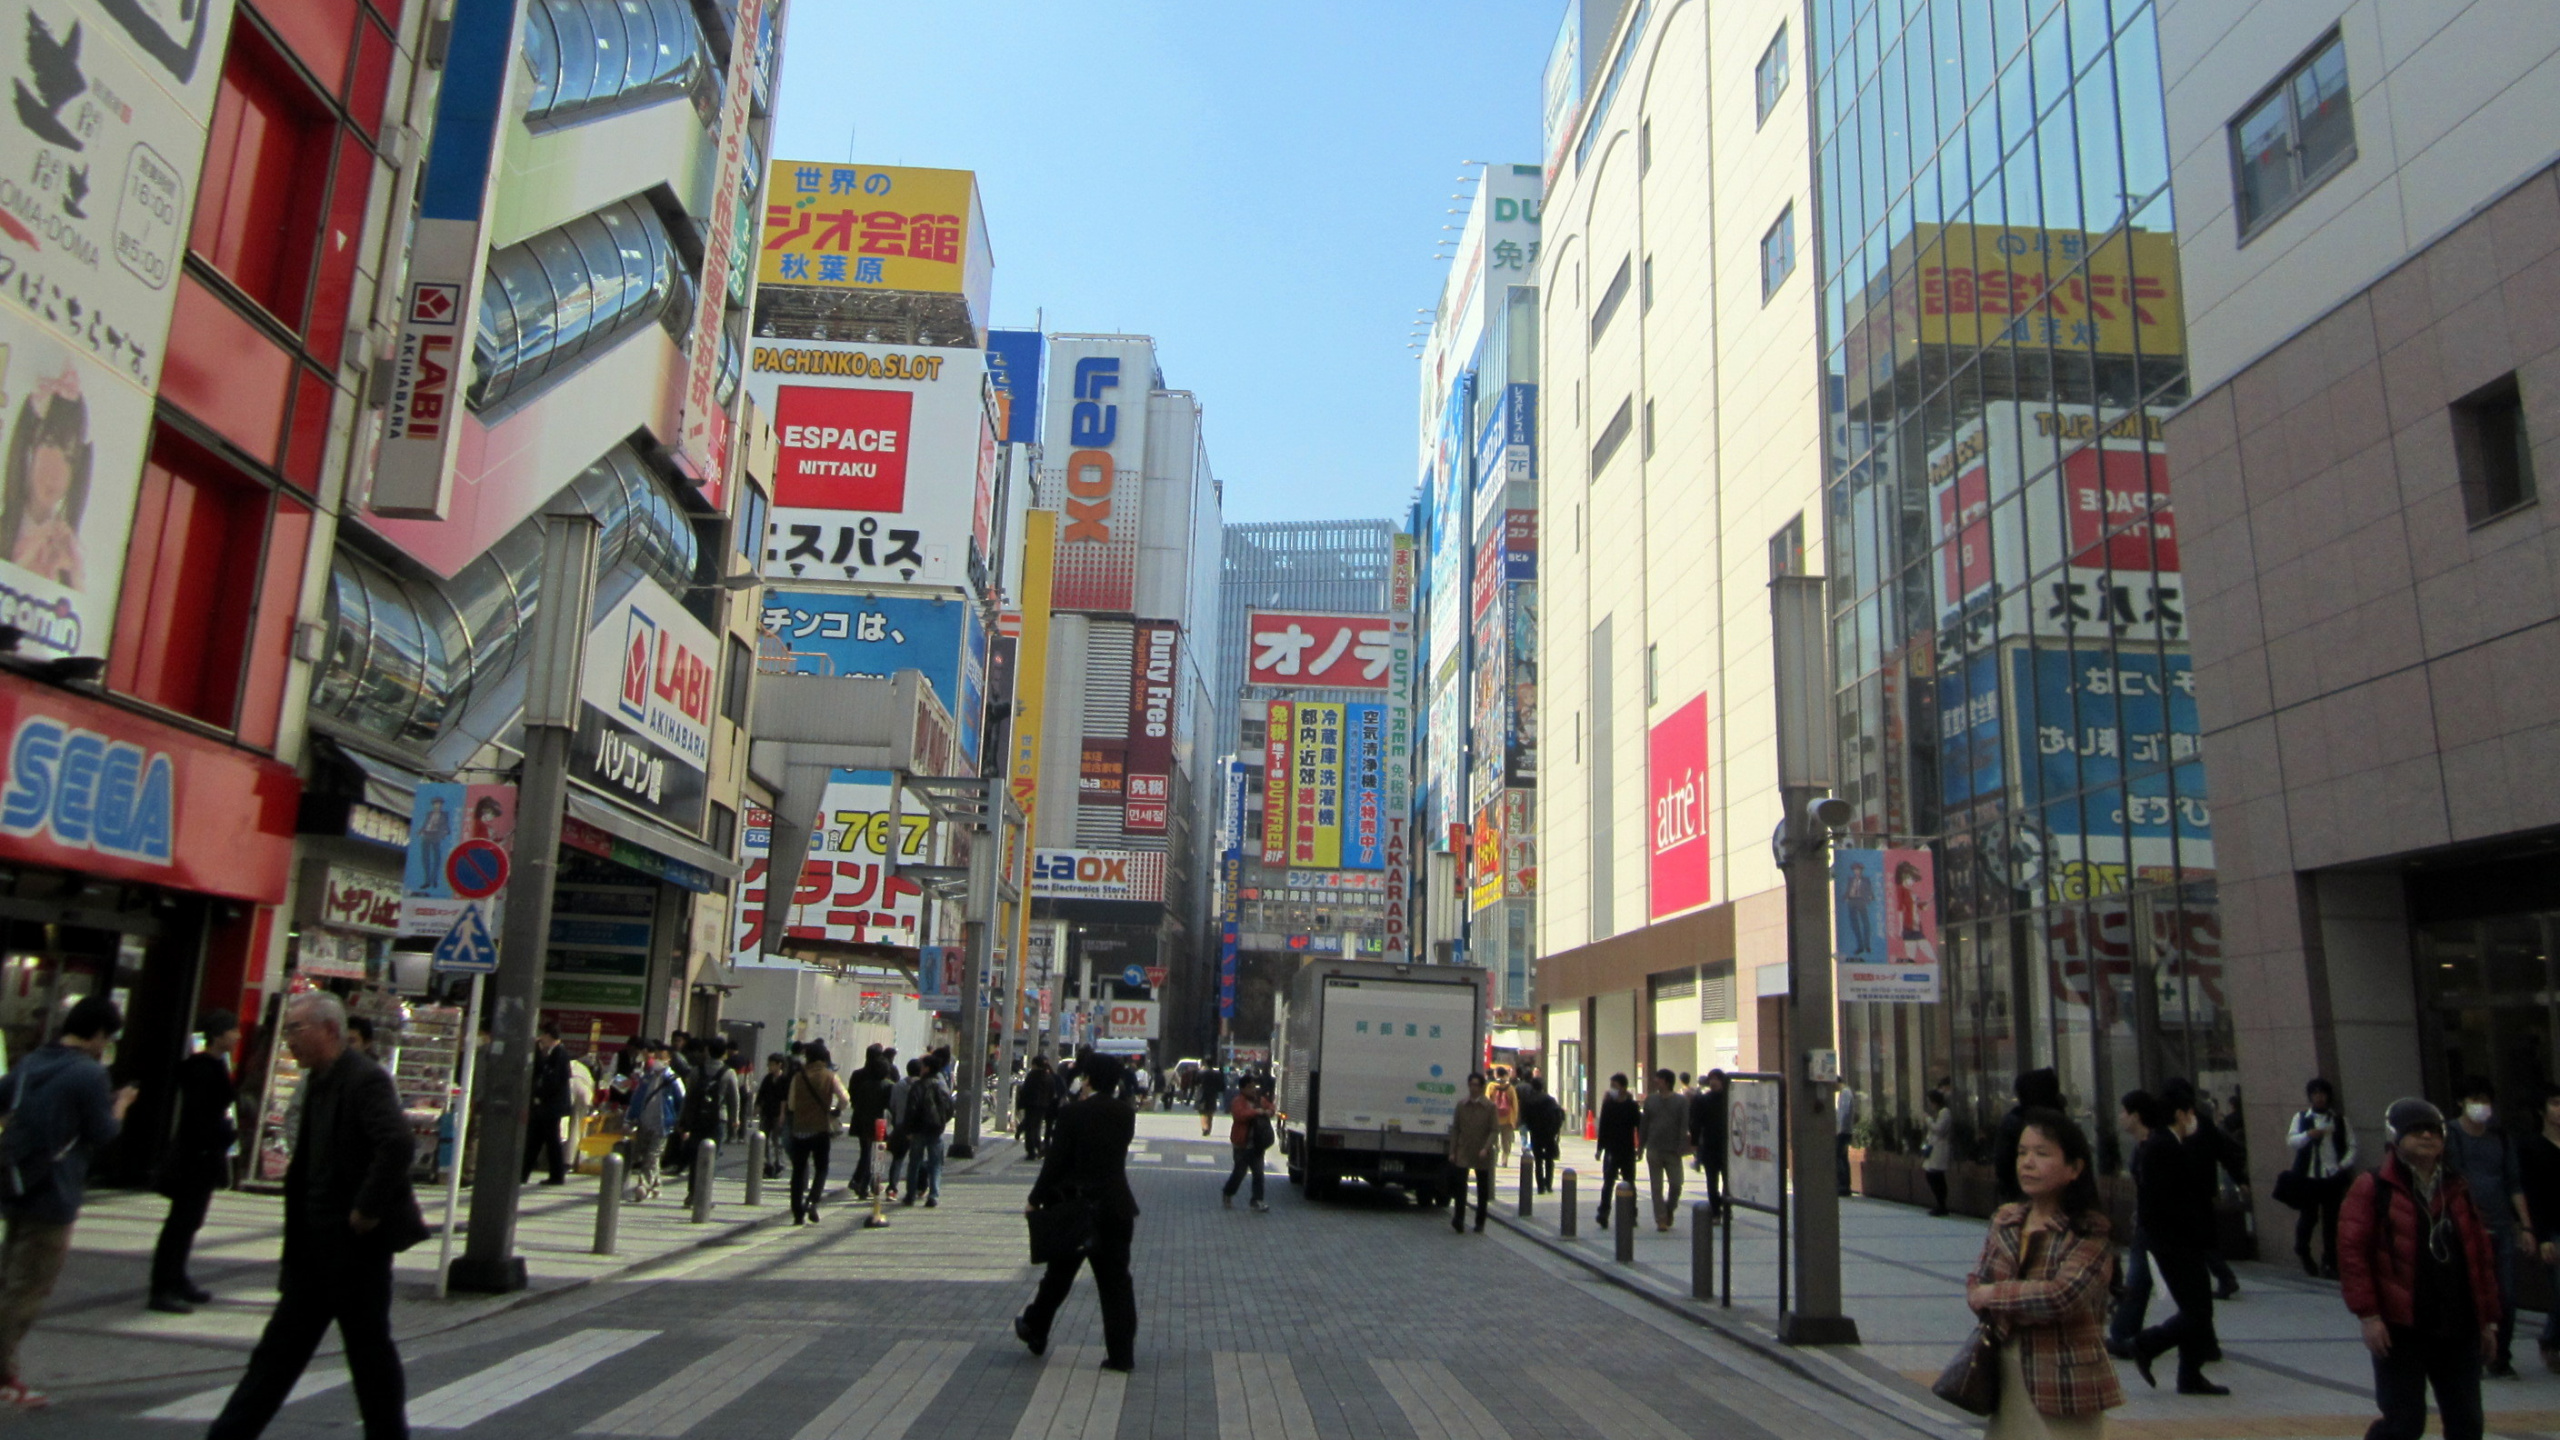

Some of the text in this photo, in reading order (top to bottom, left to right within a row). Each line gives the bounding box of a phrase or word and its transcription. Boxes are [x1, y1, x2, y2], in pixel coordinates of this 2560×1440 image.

[795, 166, 892, 196] 世界の
[780, 253, 885, 284] 秋葉原
[389, 333, 416, 440] AKIHABARA
[406, 334, 453, 440] LABI
[784, 425, 897, 452] ESPACE
[798, 460, 877, 478] NITTAKU
[1509, 460, 1528, 472] 7F
[761, 605, 905, 643] チンコは、
[655, 629, 714, 727] LABI
[1134, 629, 1150, 711] Flagship Store
[1145, 630, 1175, 738] Duty Free
[1393, 648, 1408, 701] DUTY
[649, 706, 707, 762] AKIHABARA
[1270, 705, 1289, 742] 免税
[1391, 706, 1407, 757] FREE
[1019, 734, 1034, 775] 世界の
[1318, 709, 1338, 827] 冷蔵庫洗濯機
[0, 715, 173, 867] SEGA
[1131, 779, 1165, 796] 免税
[1227, 771, 1245, 850] Panasonic
[1657, 768, 1707, 849] atré 1
[835, 810, 930, 856] 767
[1129, 808, 1164, 823] 면세점
[1264, 851, 1284, 863] B1F
[1289, 871, 1385, 888] ラジオ オーディ
[1051, 882, 1100, 893] Electronics
[1102, 884, 1127, 894] Store
[1226, 859, 1240, 923] ONODEN
[1386, 818, 1405, 952] TAKARADA
